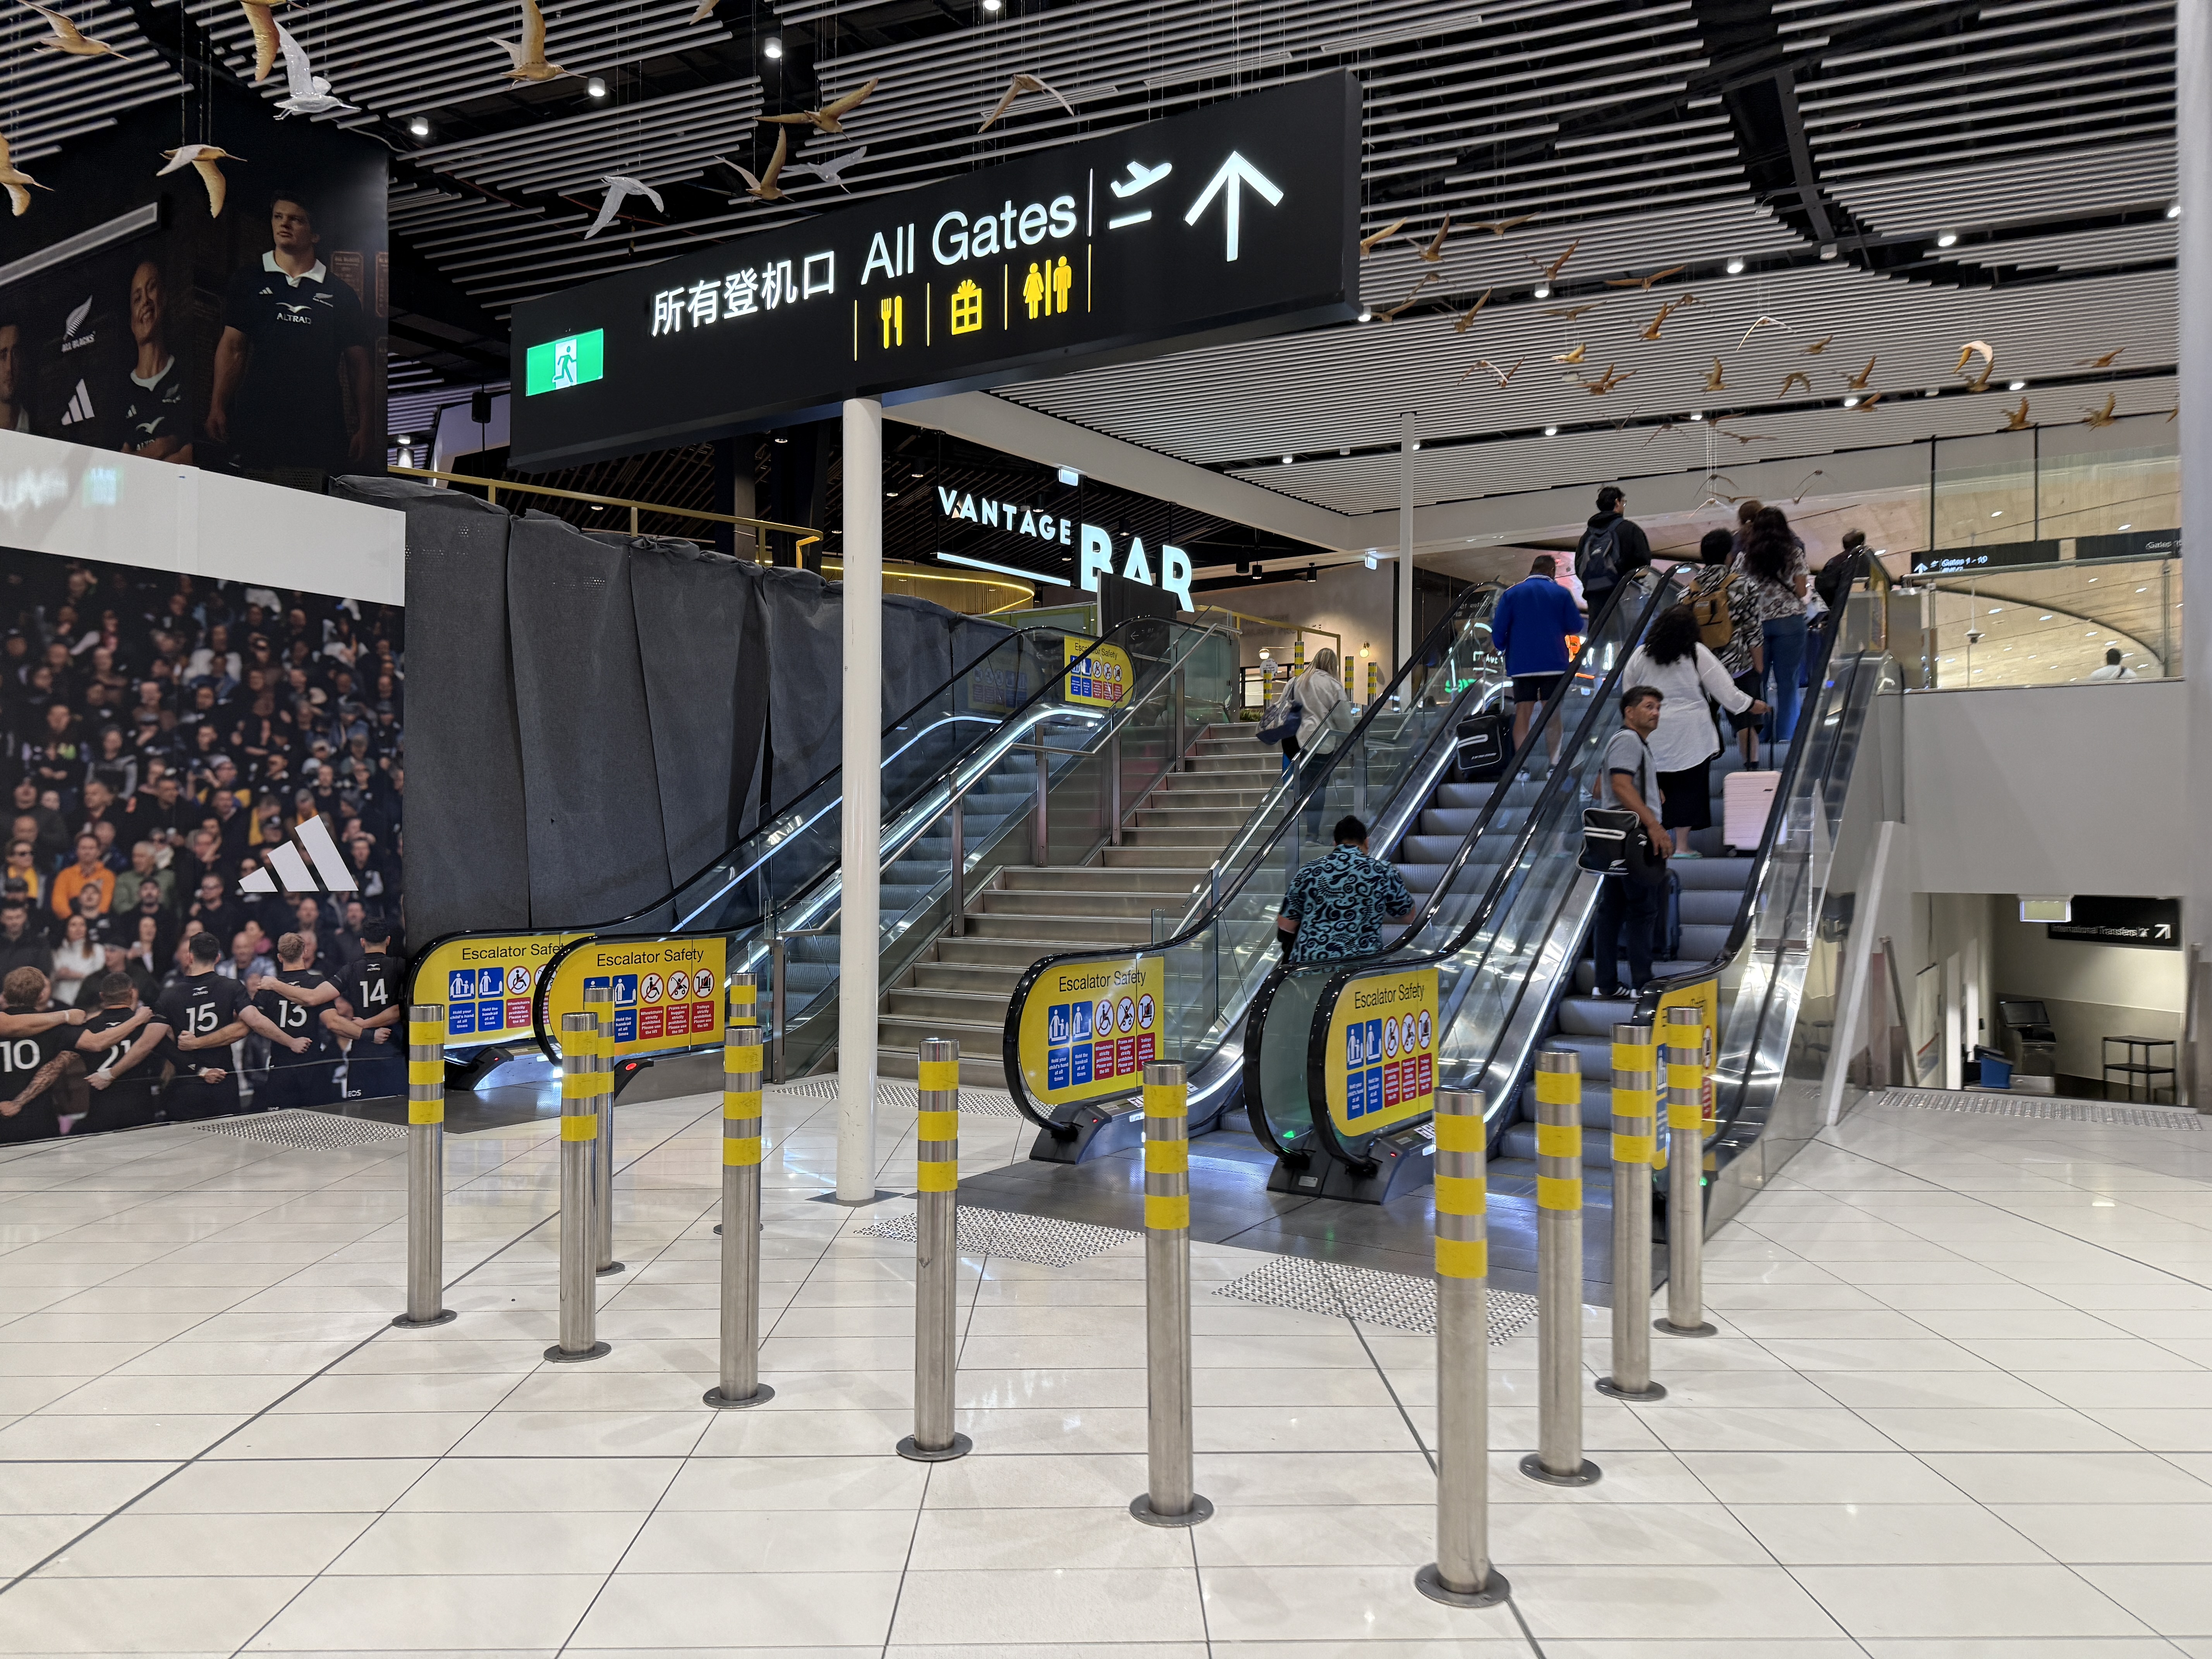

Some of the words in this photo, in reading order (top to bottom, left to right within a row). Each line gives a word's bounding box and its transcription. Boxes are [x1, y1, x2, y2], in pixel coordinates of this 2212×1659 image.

[861, 223, 915, 285] All
[932, 196, 1077, 266] Gates
[652, 251, 835, 337] 所有登机口
[277, 313, 311, 324] ALTRAD
[938, 486, 1071, 545] VANTAGE
[1081, 523, 1194, 613] BAR
[1101, 648, 1118, 660] Safety
[463, 946, 526, 960] Escalator
[598, 951, 660, 966] Escalator
[665, 948, 704, 963] Safety
[360, 978, 388, 1007] 14
[1060, 974, 1111, 992] Escalator
[1114, 969, 1146, 986] Safety
[1355, 988, 1396, 1009] Escalator
[1399, 983, 1424, 1001] Safety
[186, 1002, 218, 1034] 15
[279, 1000, 307, 1027] 13
[0, 1039, 40, 1072] 10
